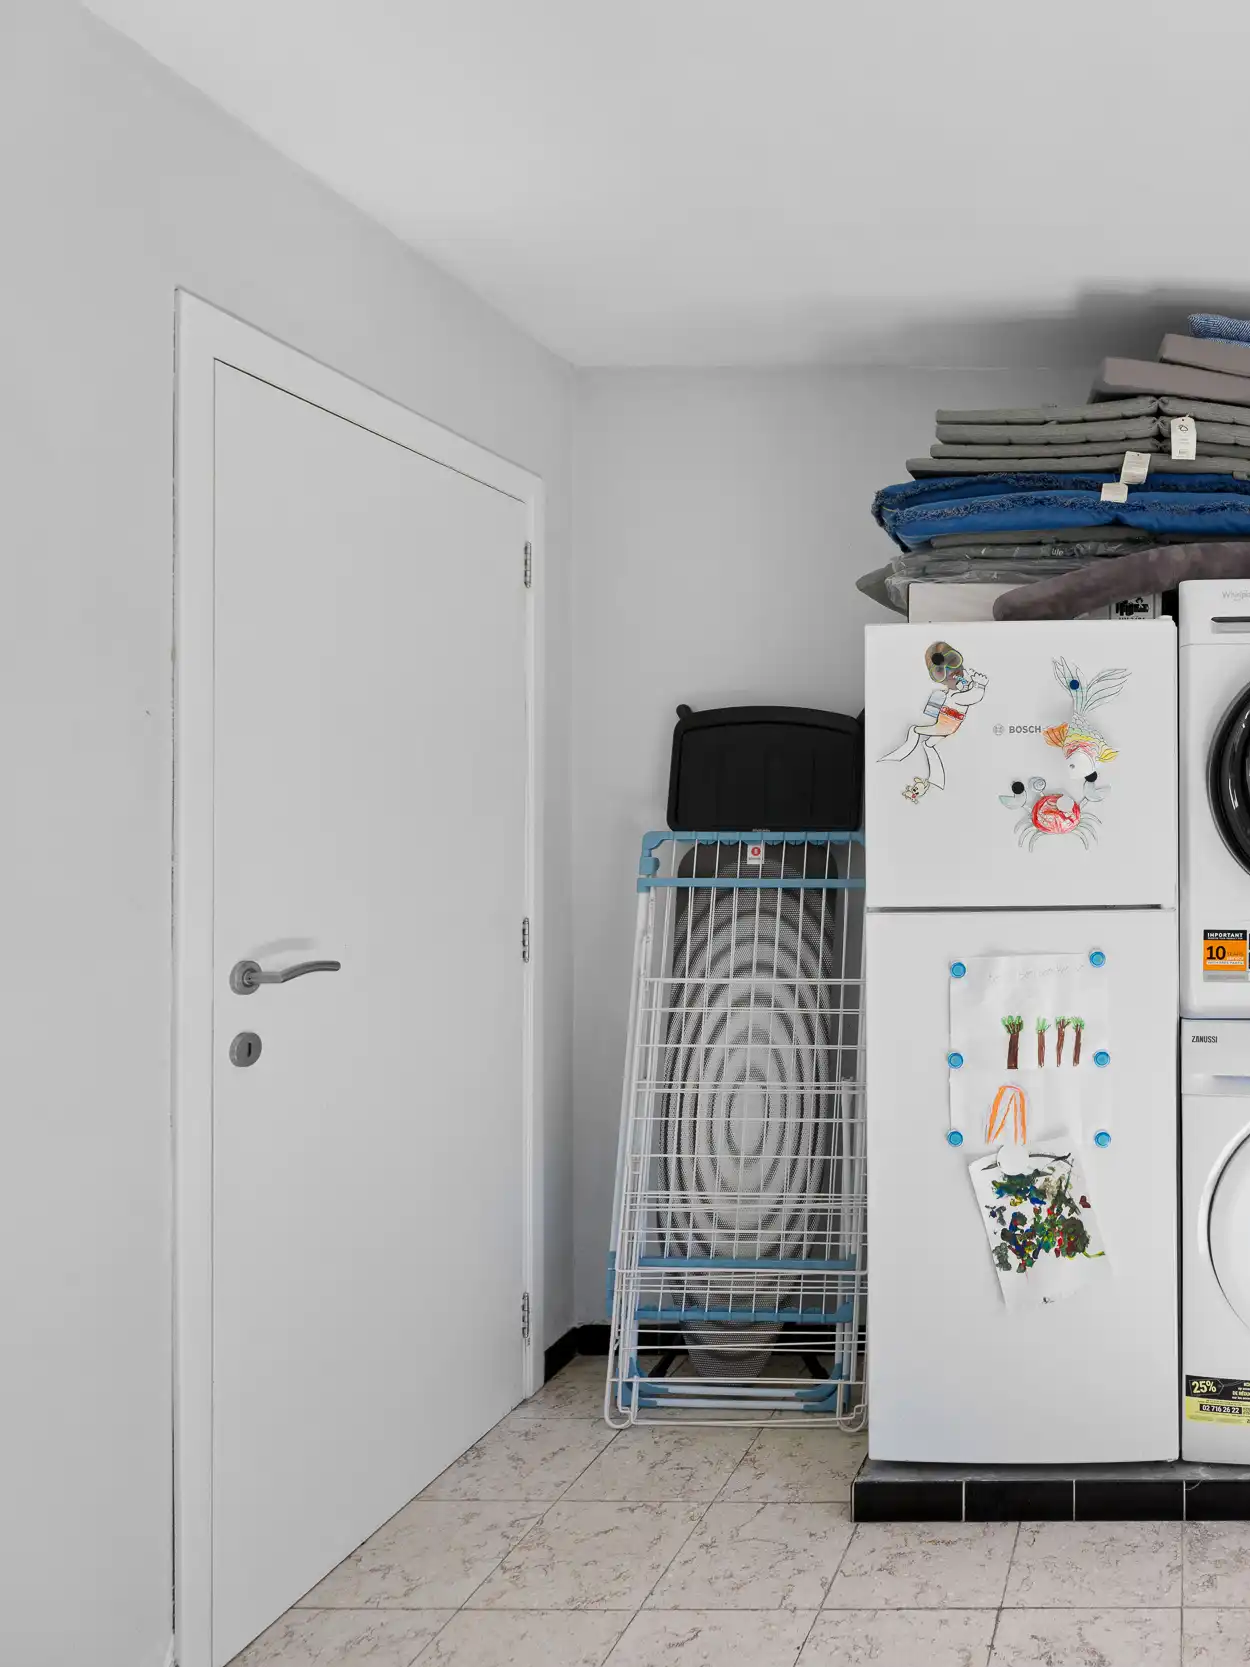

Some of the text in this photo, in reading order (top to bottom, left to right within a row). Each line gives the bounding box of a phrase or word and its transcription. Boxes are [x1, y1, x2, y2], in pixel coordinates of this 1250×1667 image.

[1009, 725, 1041, 734] BOSCH
[1206, 945, 1226, 960] 10
[1191, 1035, 1218, 1043] ZANUSSI
[1191, 1380, 1217, 1394] 25%
